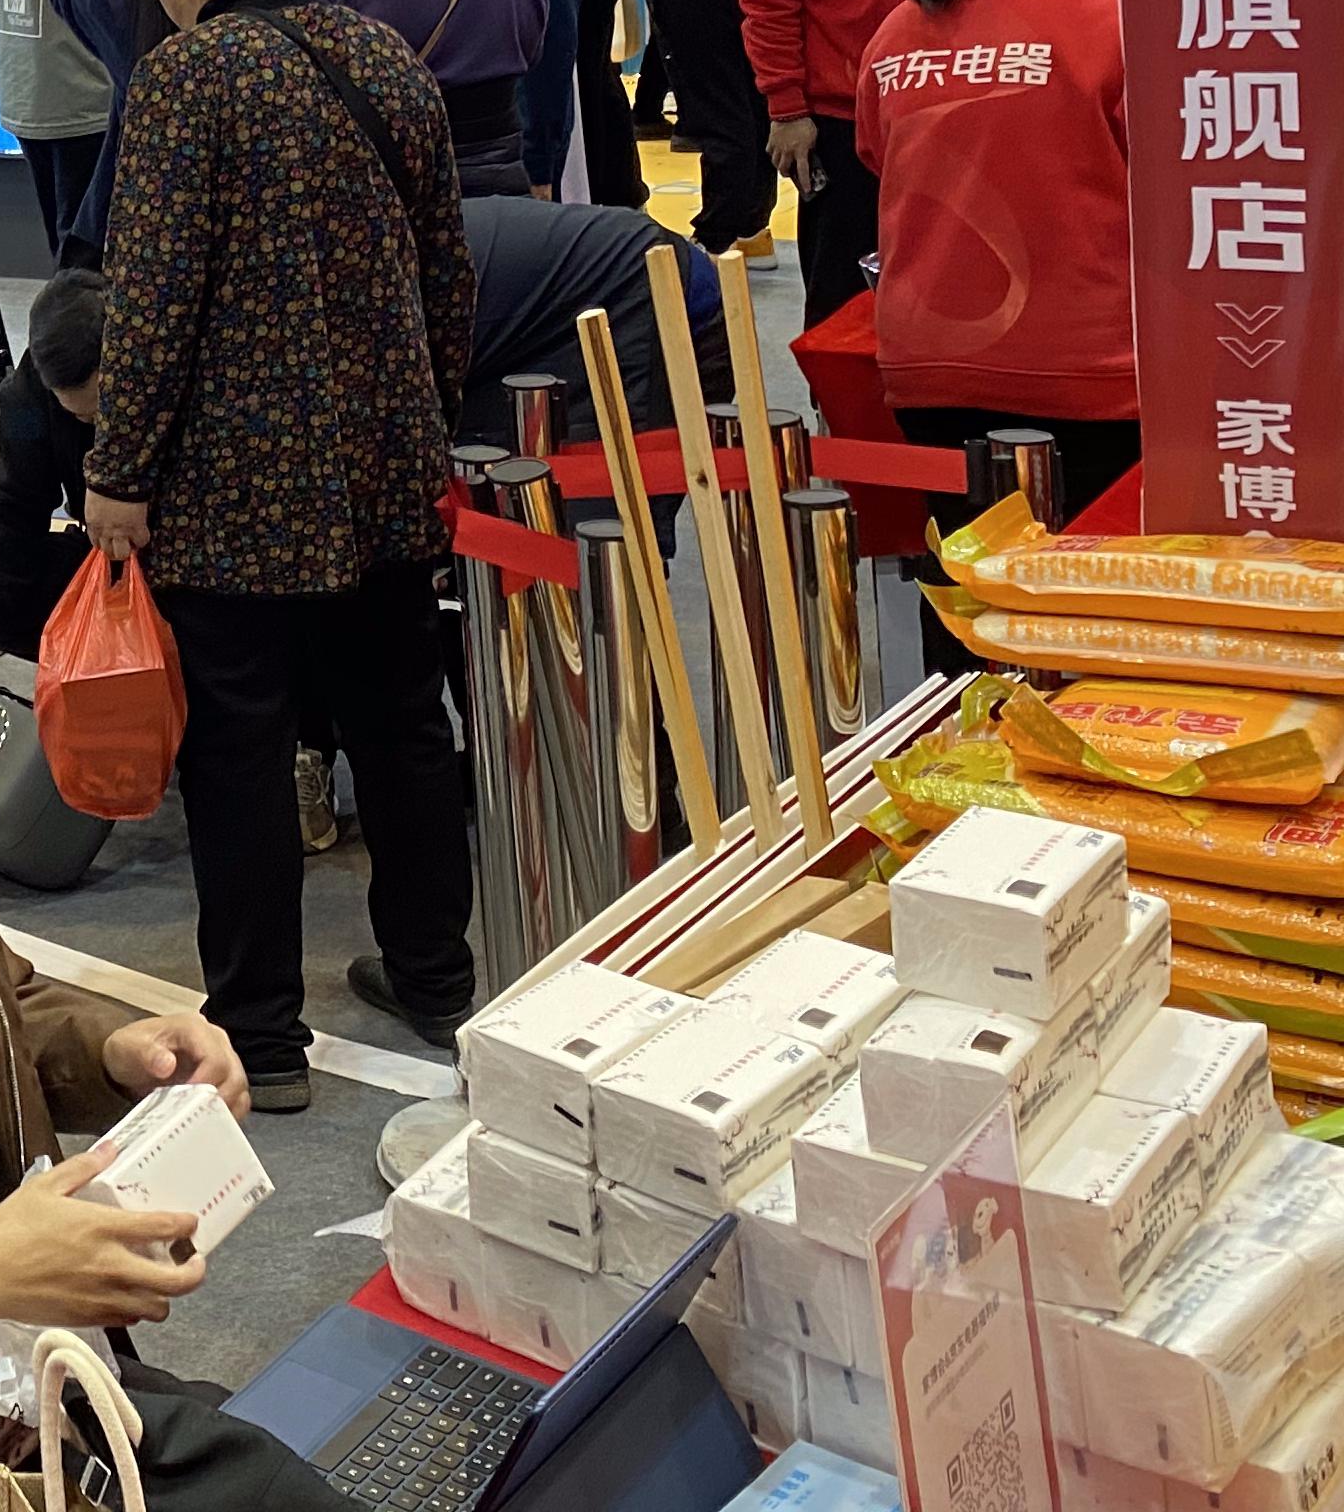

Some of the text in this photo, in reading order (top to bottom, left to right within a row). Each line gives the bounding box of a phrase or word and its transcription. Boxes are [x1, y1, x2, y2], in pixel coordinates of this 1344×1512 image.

[870, 42, 1053, 97] 京东电器
[1215, 397, 1298, 538] 家博
